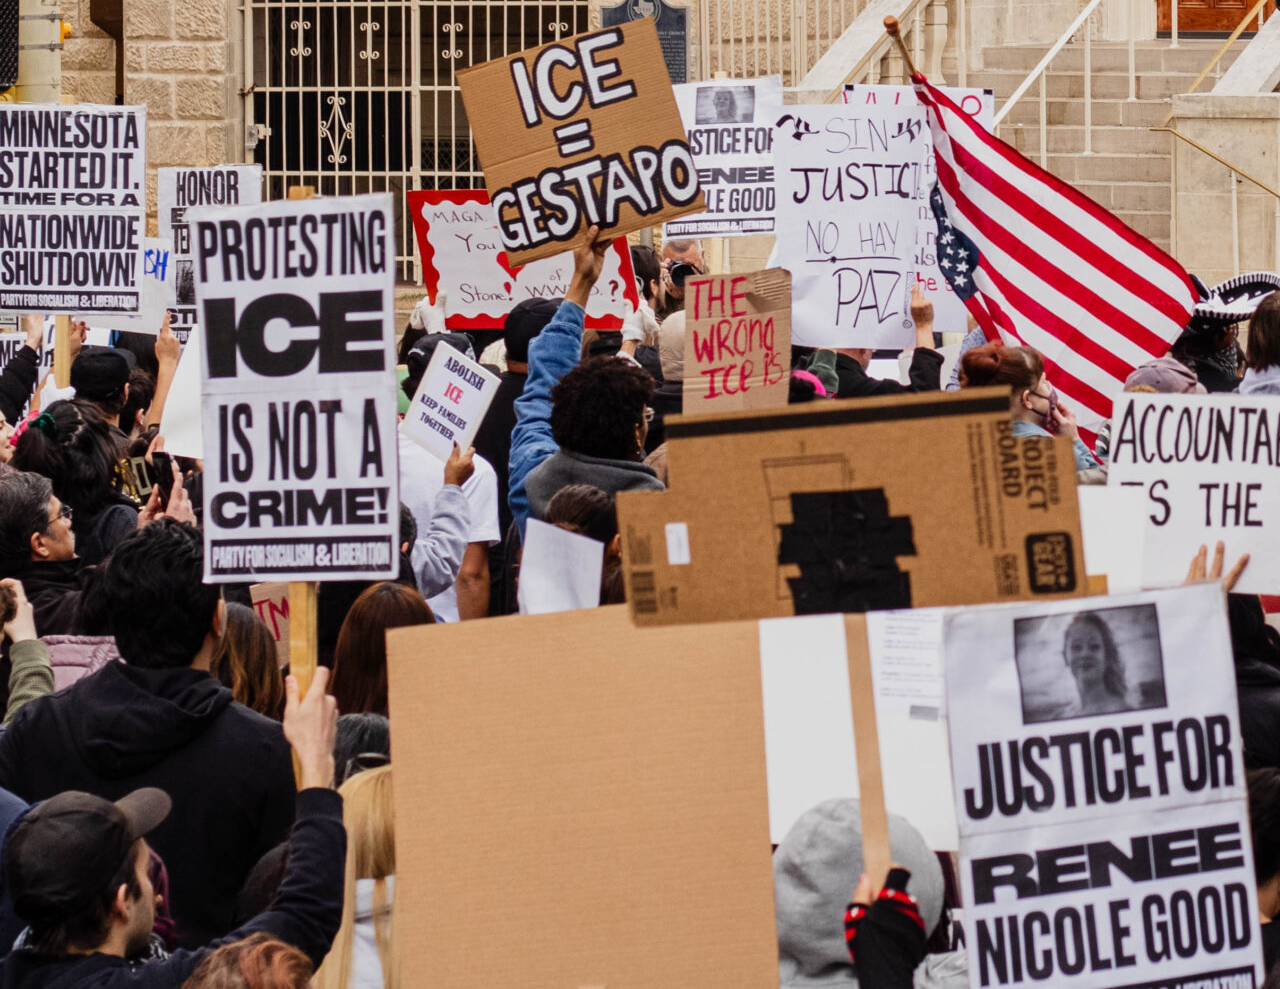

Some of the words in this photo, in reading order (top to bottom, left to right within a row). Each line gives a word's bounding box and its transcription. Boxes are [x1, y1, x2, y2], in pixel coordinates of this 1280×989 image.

[510, 27, 638, 129] ICE
[0, 110, 140, 149] MINNESOTA
[824, 117, 889, 155] SIN
[0, 150, 106, 190] STARTED
[111, 152, 140, 190] IT.
[176, 169, 240, 207] HONOR
[0, 192, 57, 206] TIME
[60, 192, 115, 207] FOR
[120, 193, 140, 207] A
[491, 138, 701, 253] GESTAPO
[728, 187, 776, 213] GOOD
[0, 213, 140, 250] NATIONWIDE
[196, 210, 386, 283] PROTESTING
[454, 233, 497, 253] You
[805, 219, 840, 255] NO
[858, 219, 900, 256] HAY
[0, 250, 137, 287] SHUTDOWN!
[549, 269, 562, 281] of
[1, 293, 23, 307] PARTY
[23, 293, 38, 307] FOR
[38, 293, 80, 308] SOCIALISM
[80, 295, 91, 308] &
[91, 294, 138, 309] LIBERATION
[689, 276, 748, 322] THE
[202, 289, 386, 379] ICE
[444, 356, 487, 392] ABOLISH
[420, 393, 439, 411] KEEP
[438, 405, 467, 431] FAMILIES
[443, 382, 464, 405] ICE
[218, 402, 254, 483] IS
[267, 399, 343, 481] NOT
[359, 398, 384, 479] A
[420, 412, 455, 441] TOGETHER
[210, 487, 390, 530] CRIME!
[1199, 482, 1263, 528] THE
[211, 545, 246, 569] PARTY
[315, 543, 331, 567] &
[331, 541, 391, 566] LIBERATION
[963, 725, 1153, 822] JUSTICE
[1152, 714, 1235, 798] FOR
[971, 822, 1246, 907] RENEE
[975, 898, 1137, 989] NICOLE
[1141, 881, 1251, 965] GOOD
